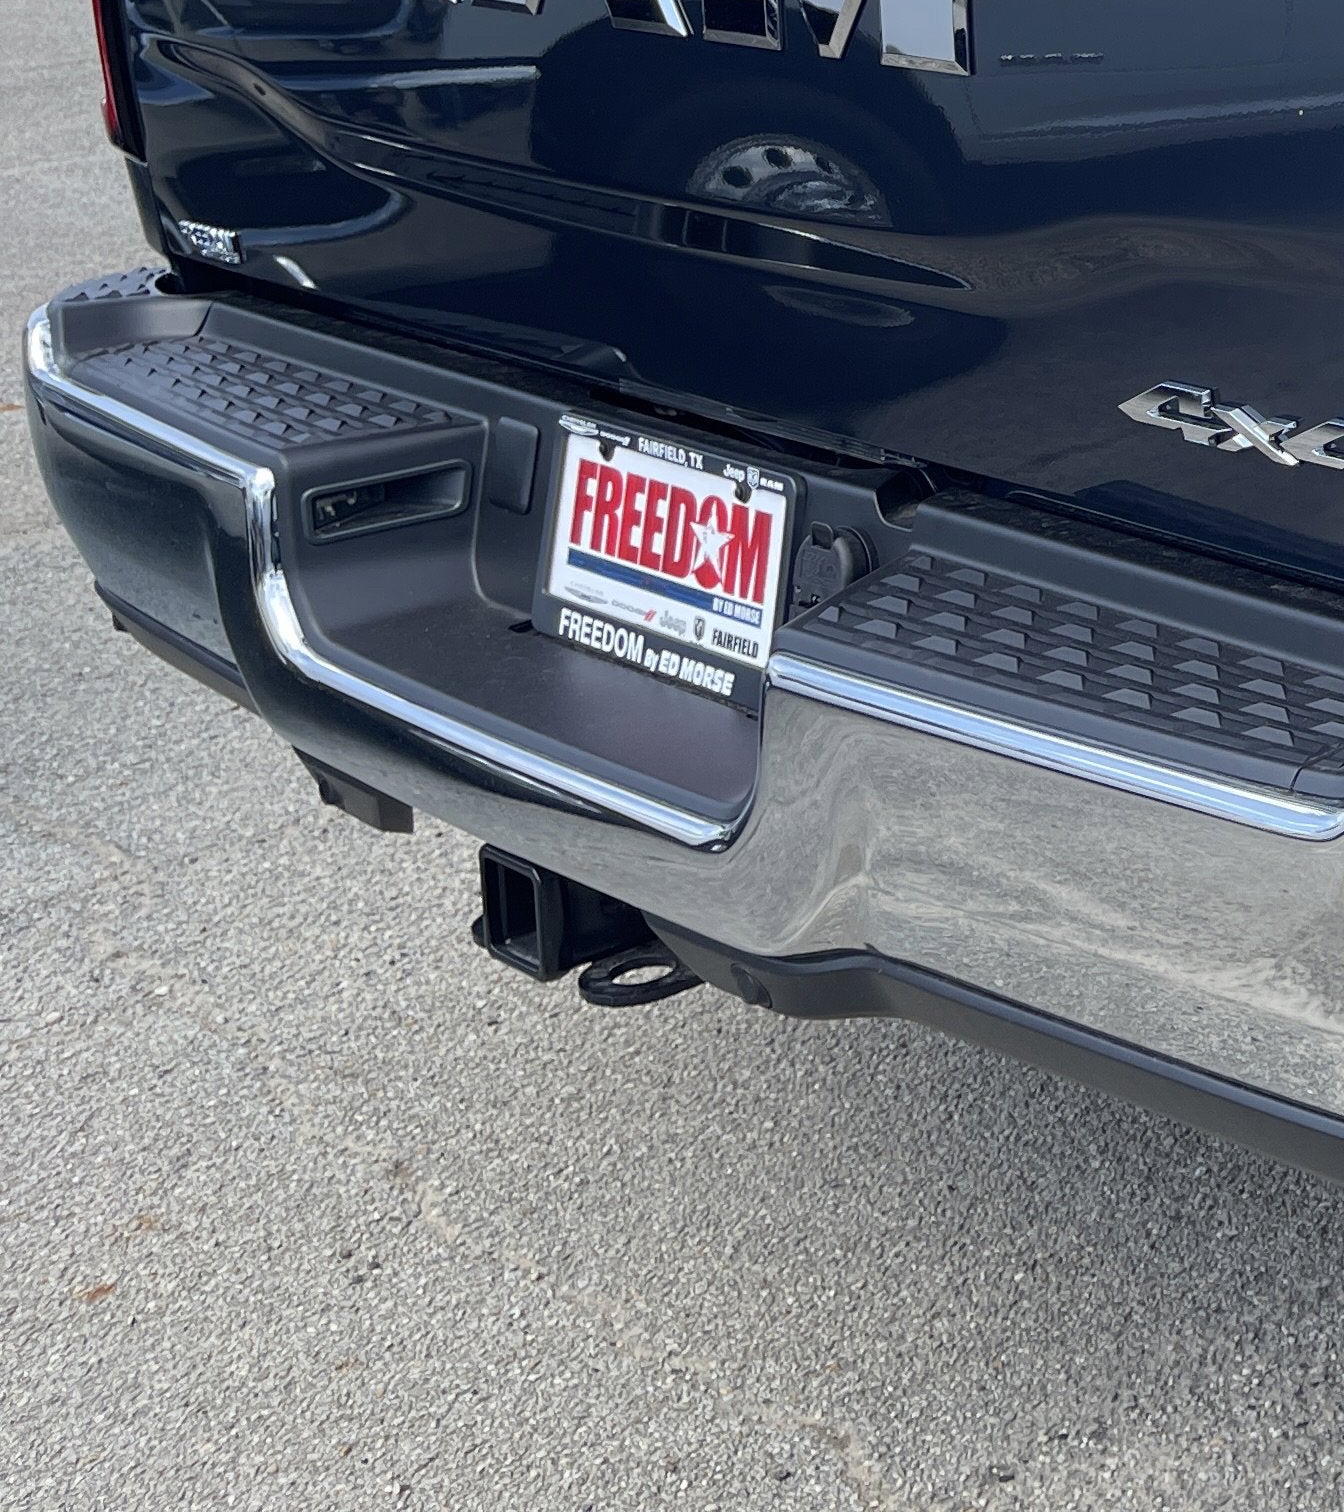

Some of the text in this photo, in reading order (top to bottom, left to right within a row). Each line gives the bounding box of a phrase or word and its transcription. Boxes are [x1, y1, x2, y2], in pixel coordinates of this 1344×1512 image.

[689, 452, 704, 470] TX
[723, 464, 745, 483] Jeep
[569, 458, 774, 605] FREEDOM
[660, 610, 687, 637] Jeep
[724, 601, 734, 616] ED
[734, 603, 761, 625] MORSE
[558, 606, 645, 664] FREEDOM
[658, 648, 681, 677] ED
[678, 656, 736, 697] MORSE
[711, 628, 759, 659] FAIRFIELD
